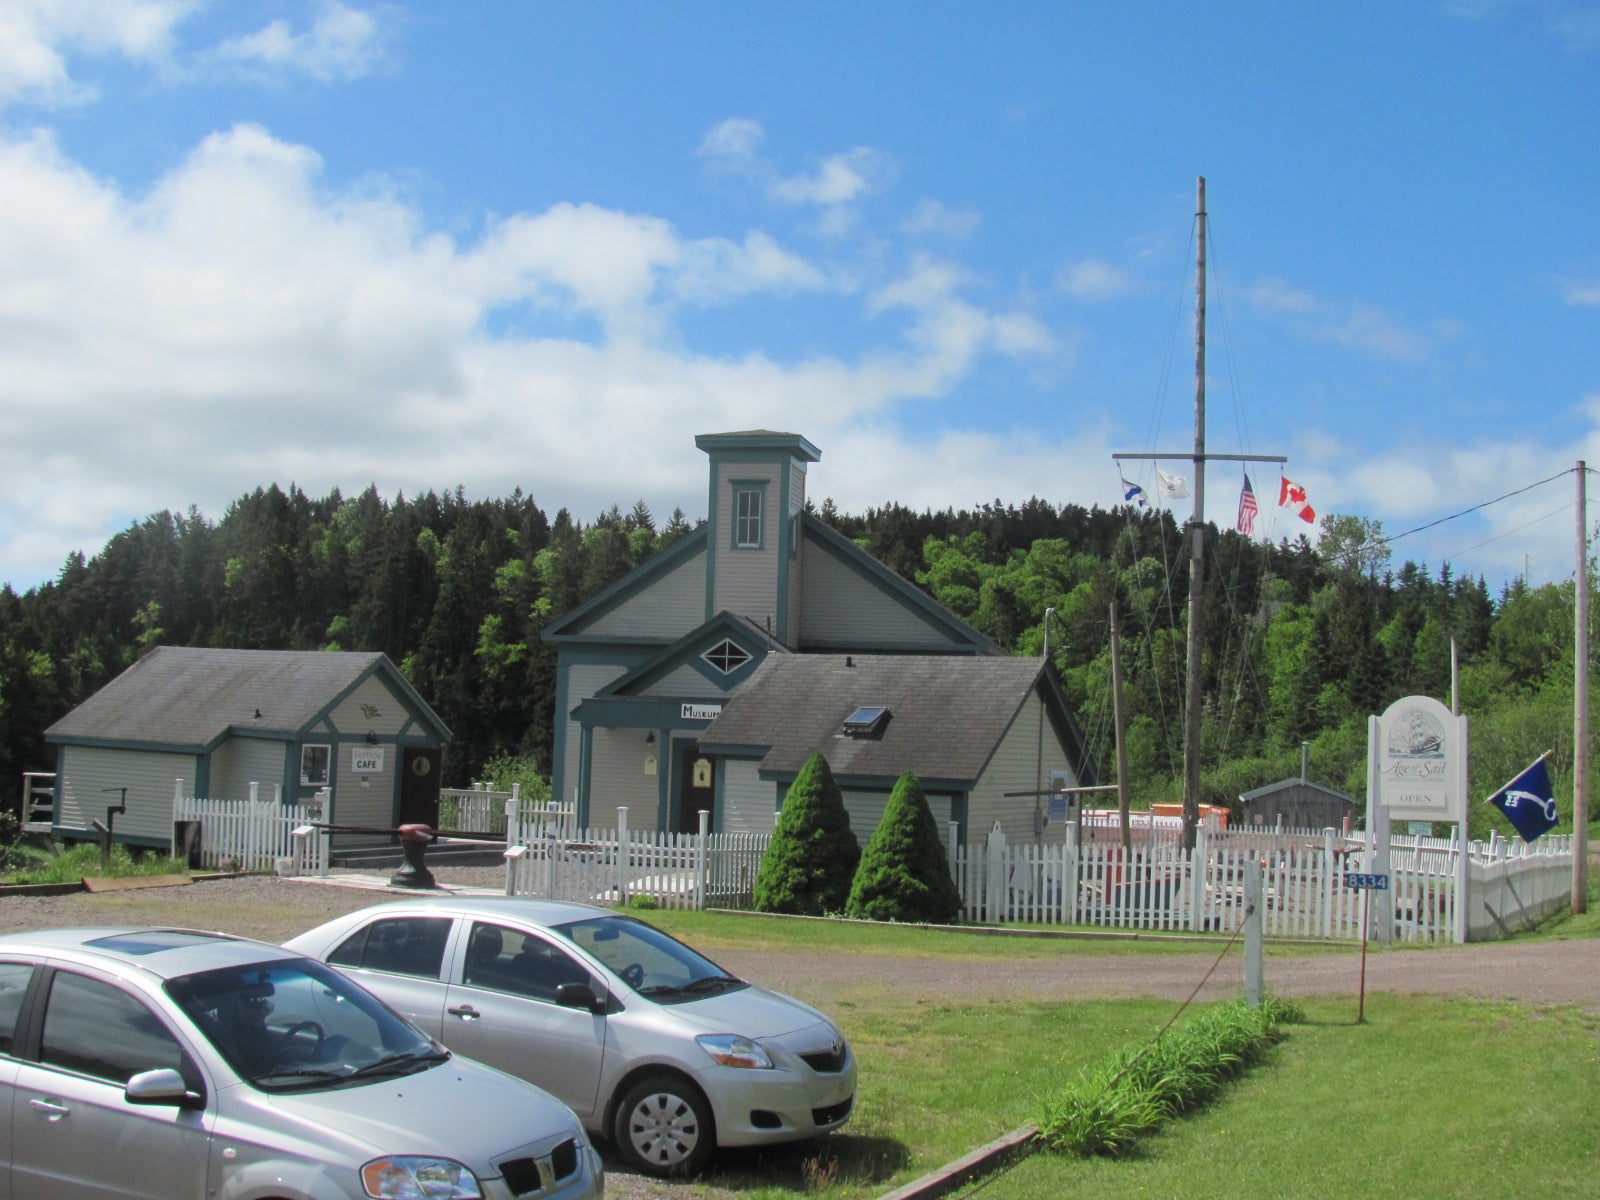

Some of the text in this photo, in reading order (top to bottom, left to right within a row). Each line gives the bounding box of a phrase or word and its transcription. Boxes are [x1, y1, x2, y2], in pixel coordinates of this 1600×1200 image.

[356, 760, 377, 769] CAFE
[1379, 761, 1408, 777] Age
[1419, 761, 1447, 777] Sail
[1400, 794, 1432, 802] OPEN
[1348, 874, 1386, 888] 8334
